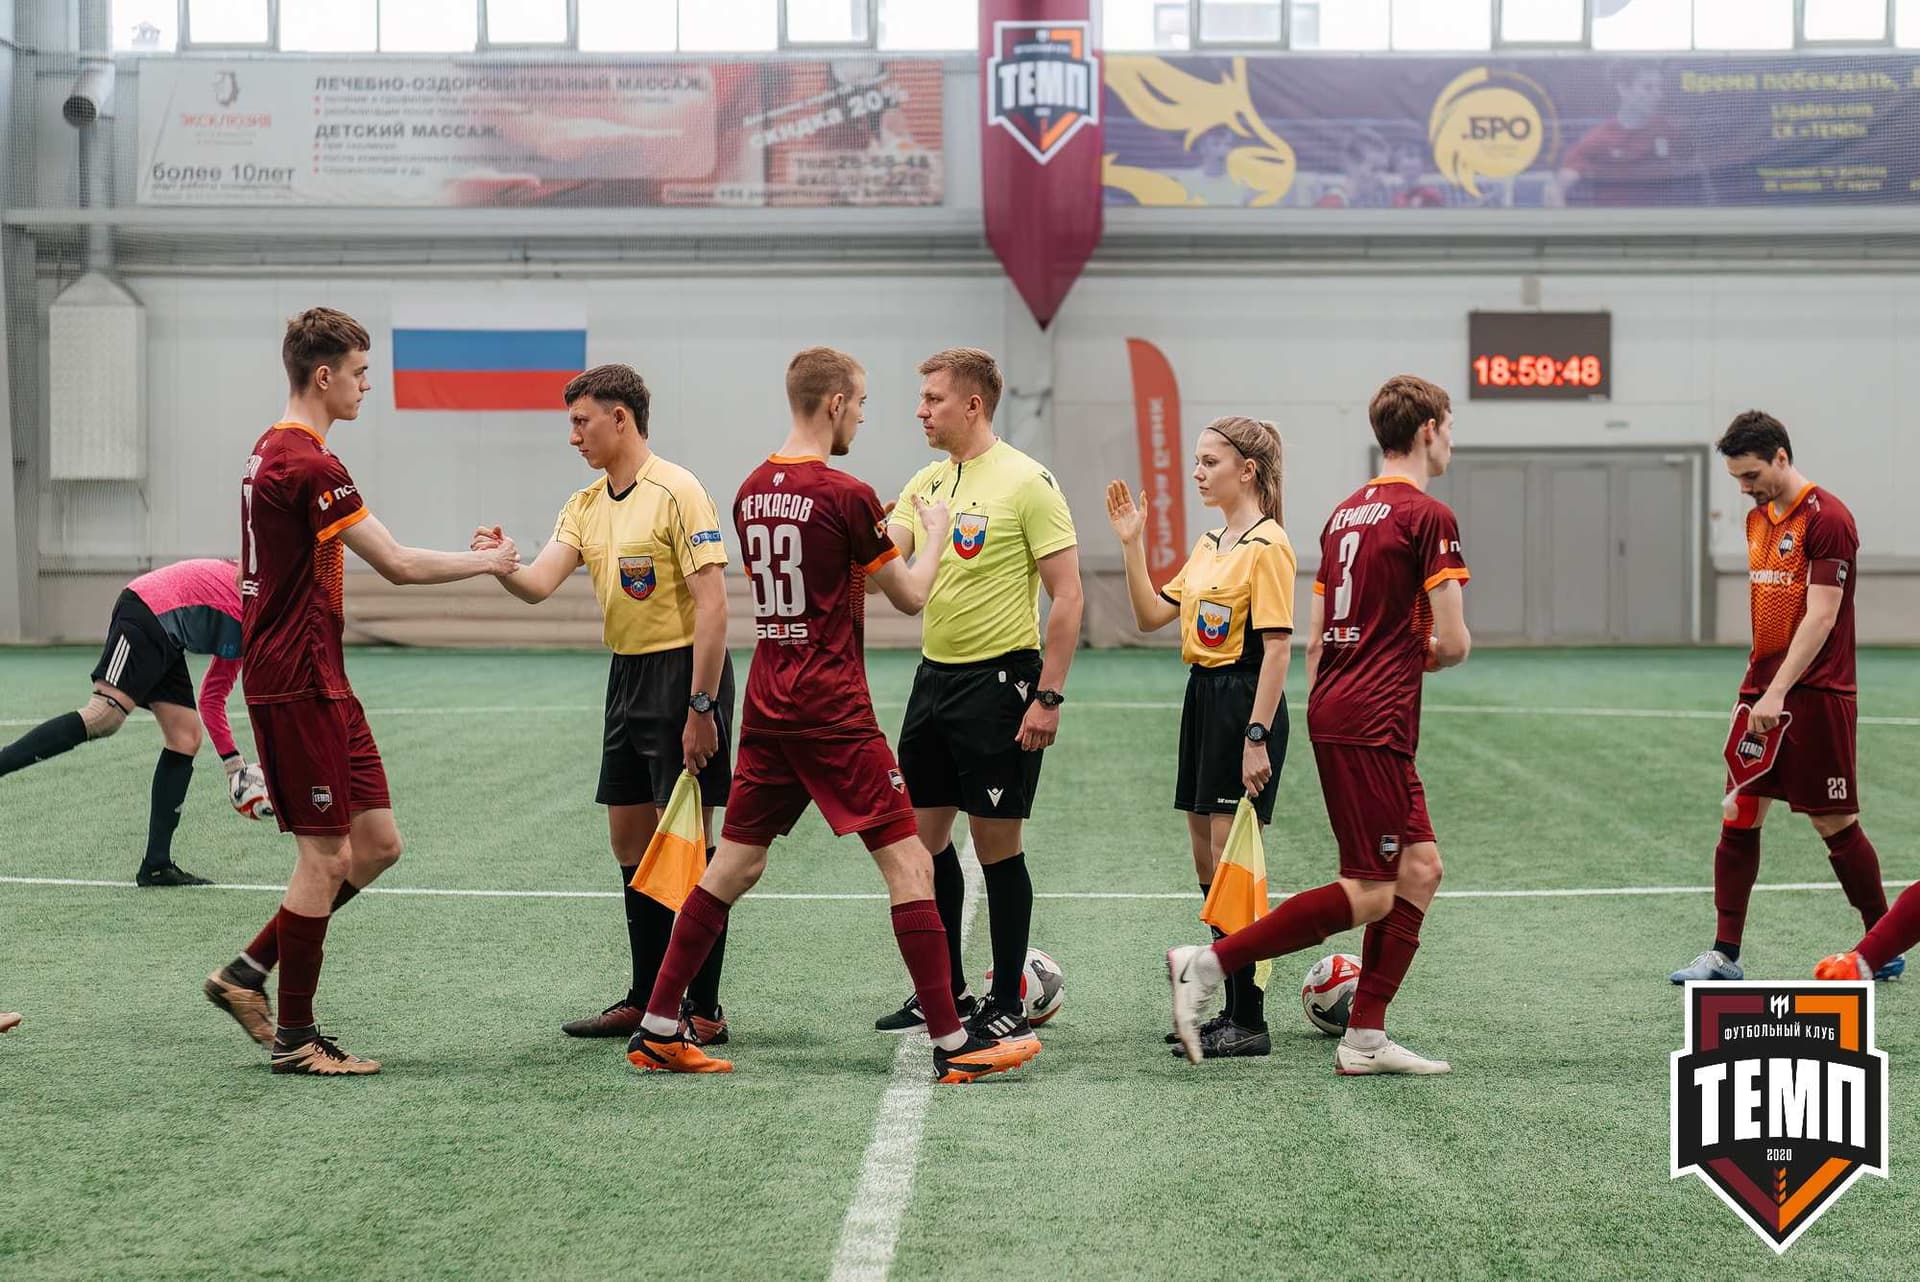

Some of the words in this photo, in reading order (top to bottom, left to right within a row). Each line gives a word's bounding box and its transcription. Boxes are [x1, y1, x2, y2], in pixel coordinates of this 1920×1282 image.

[999, 60, 1087, 110] ТЕМП
[315, 121, 404, 138] ДЕТСКИЙ
[153, 162, 222, 181] более
[1473, 355, 1601, 386] 18:59:48
[742, 493, 814, 522] ЧЕРКАСОВ
[746, 524, 807, 617] 33
[1333, 531, 1361, 621] 3
[1827, 777, 1847, 800] 23
